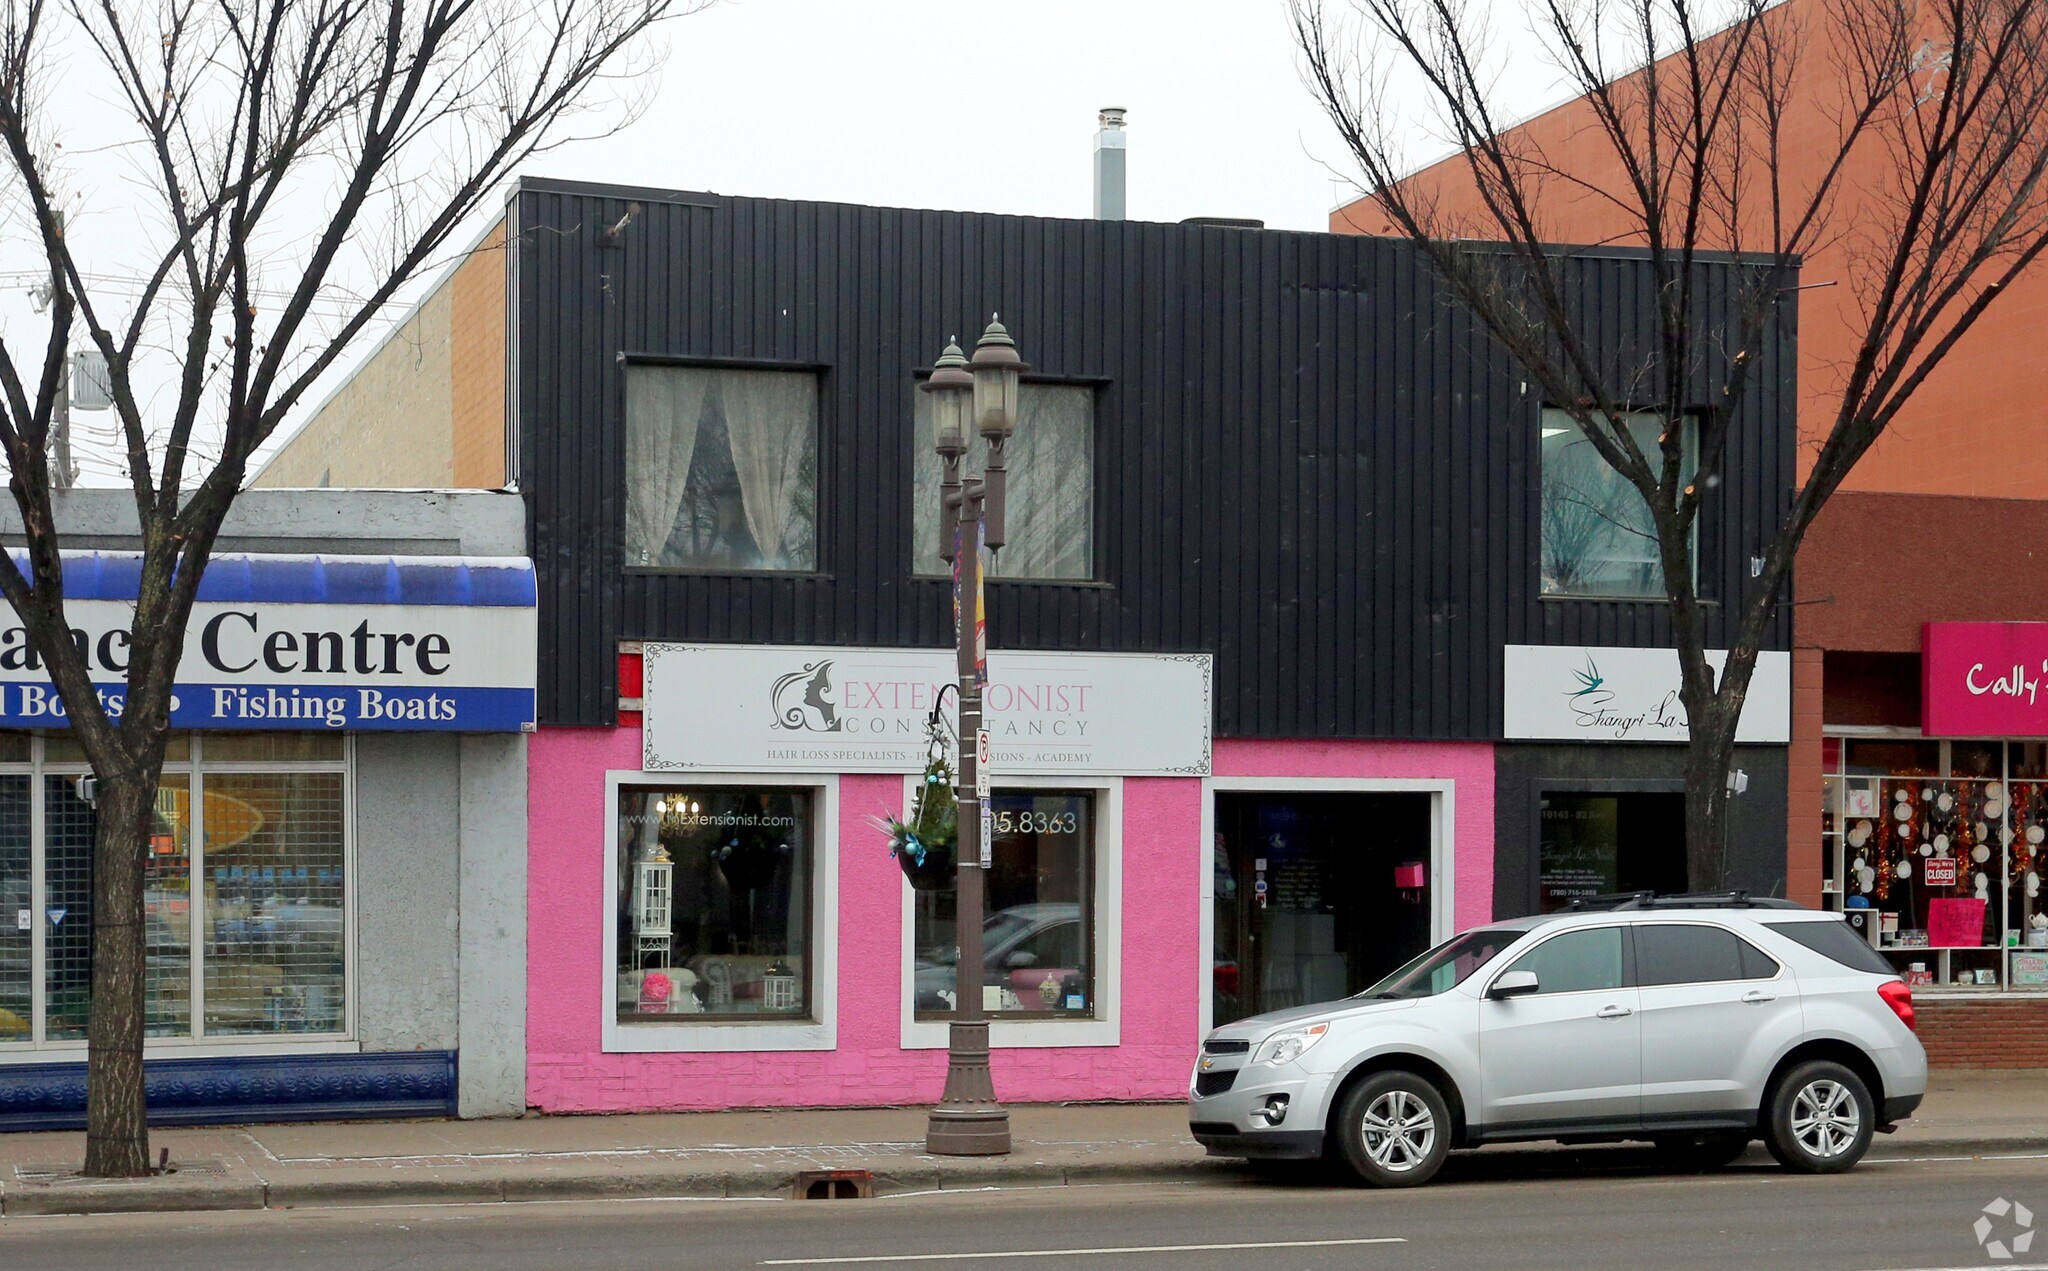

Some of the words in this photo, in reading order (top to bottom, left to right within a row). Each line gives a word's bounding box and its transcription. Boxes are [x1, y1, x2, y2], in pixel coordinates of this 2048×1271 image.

[201, 611, 450, 675] Centre
[18, 685, 124, 718] Bots
[211, 687, 347, 728] Fishing
[356, 688, 457, 721] Boats
[843, 682, 1093, 713] EXTENONIST
[845, 717, 1089, 736] CONSUTANCY
[1568, 689, 1647, 739] Shangri
[1648, 689, 1678, 728] La
[767, 750, 798, 760] HAIR
[802, 750, 830, 760] LOSS
[833, 751, 906, 761] SPECIALISTS
[950, 752, 1024, 762] ESIONS
[1034, 753, 1092, 763] ACADEMY
[1927, 869, 1954, 880] CLOSED
